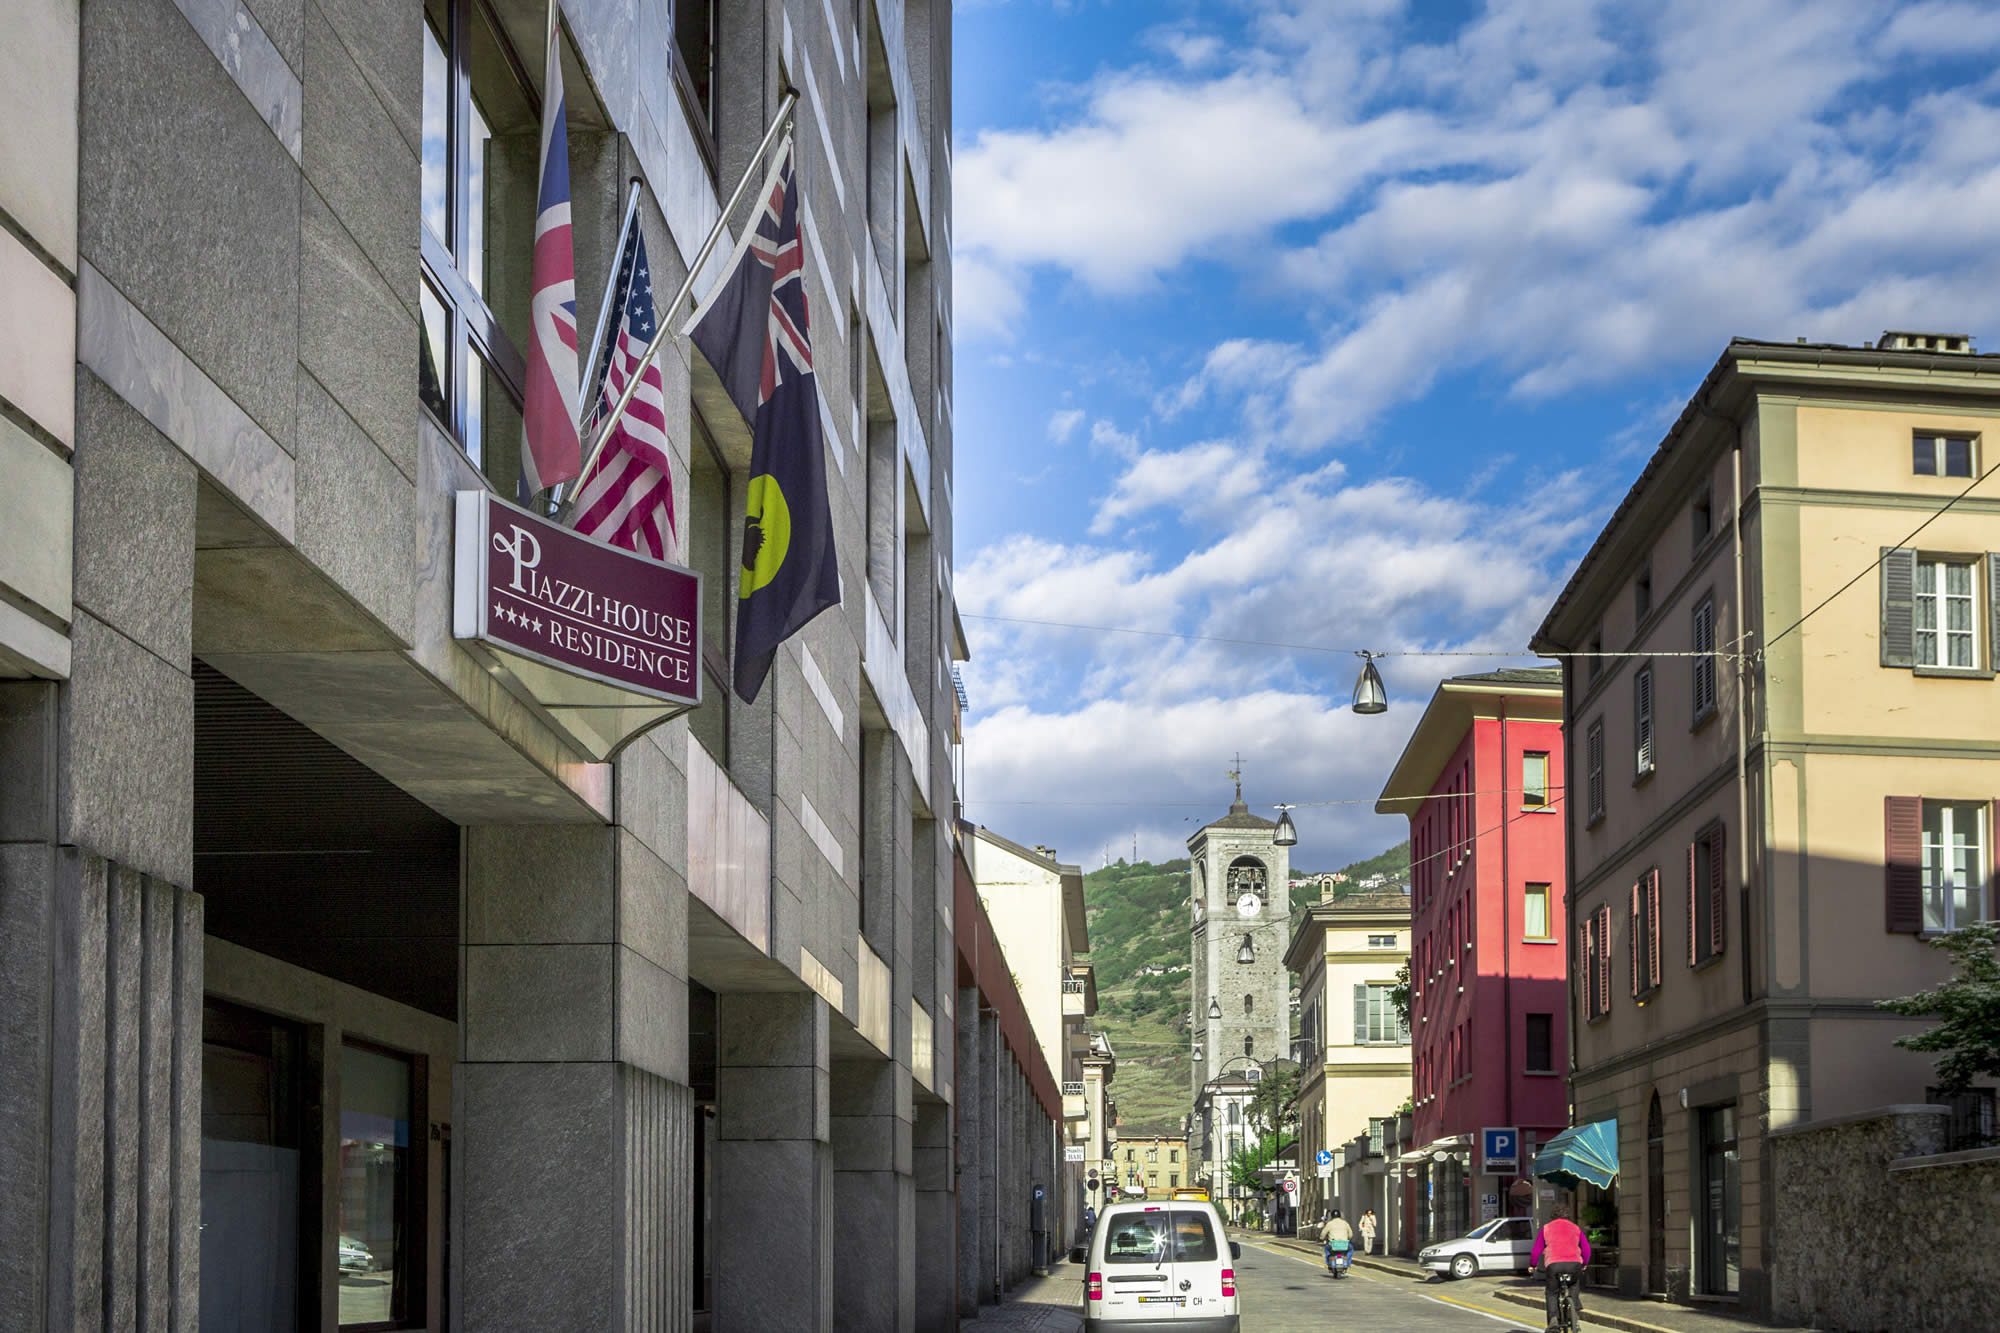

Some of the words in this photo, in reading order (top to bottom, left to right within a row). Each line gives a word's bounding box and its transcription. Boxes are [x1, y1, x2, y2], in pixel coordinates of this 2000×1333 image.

[549, 620, 690, 683] RESIDENCE
[1496, 1136, 1509, 1153] P
[1035, 1190, 1043, 1199] P
[1489, 1195, 1496, 1203] P
[1193, 1298, 1203, 1306] CH
